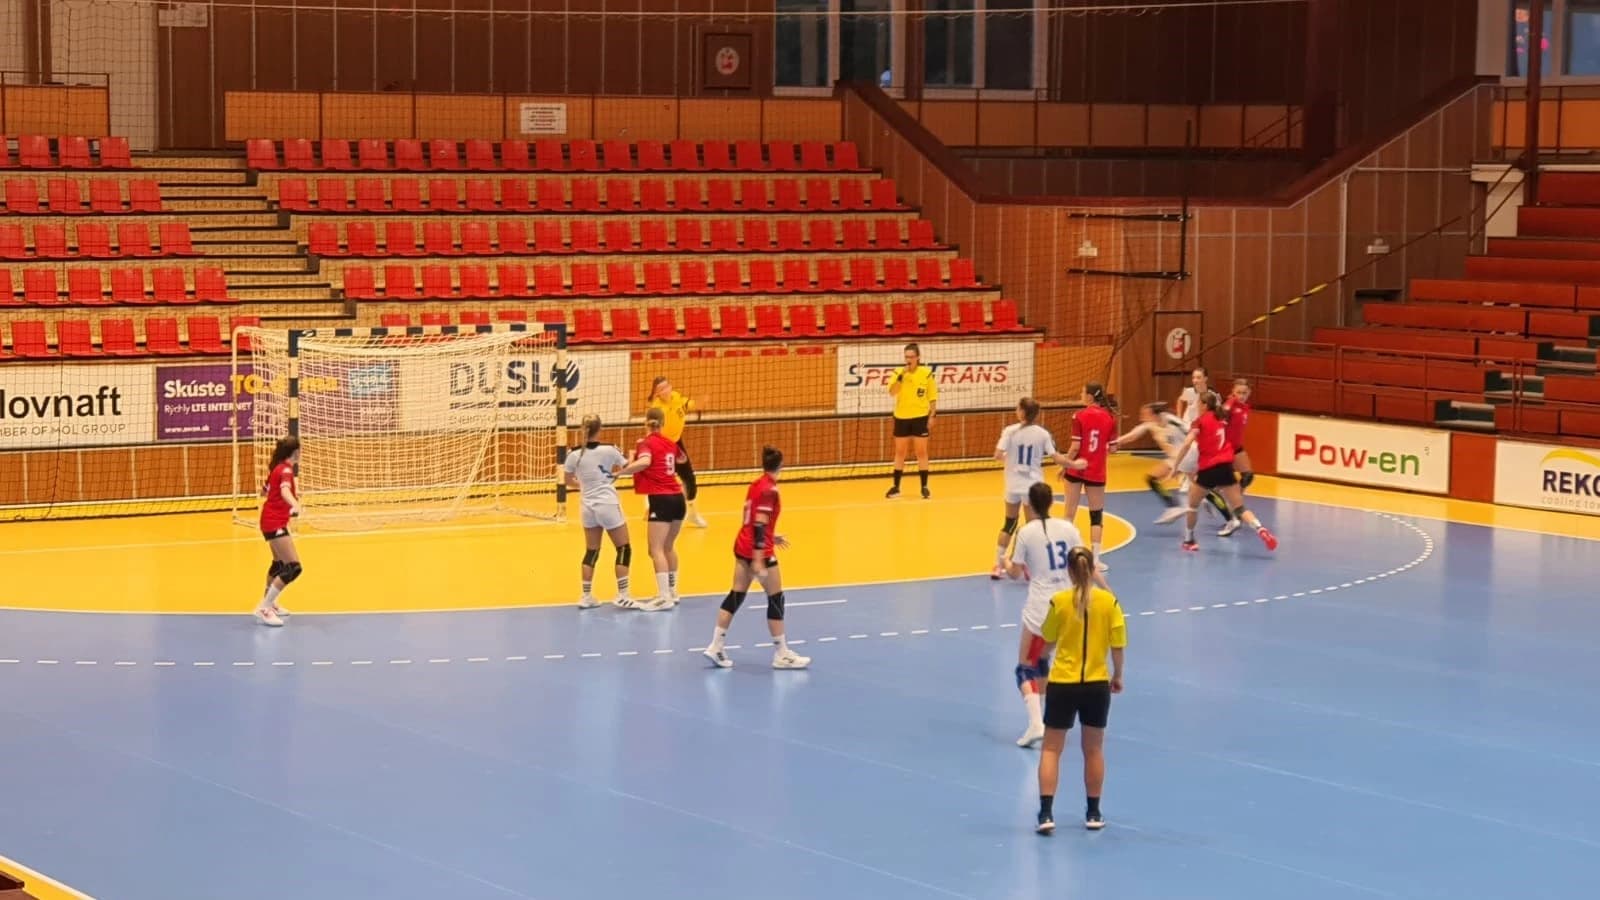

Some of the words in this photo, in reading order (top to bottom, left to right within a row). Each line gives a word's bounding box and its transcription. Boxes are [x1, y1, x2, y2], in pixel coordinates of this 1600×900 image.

[843, 361, 1009, 387] SPETRANS
[164, 379, 226, 399] Skúste
[191, 402, 207, 412] LTE
[0, 426, 27, 438] BER
[31, 425, 48, 436] OF
[82, 423, 126, 435] GROUP
[1089, 429, 1100, 452] 5
[1018, 444, 1034, 466] 11
[1294, 433, 1420, 476] Pow-en
[1046, 541, 1068, 571] 13
